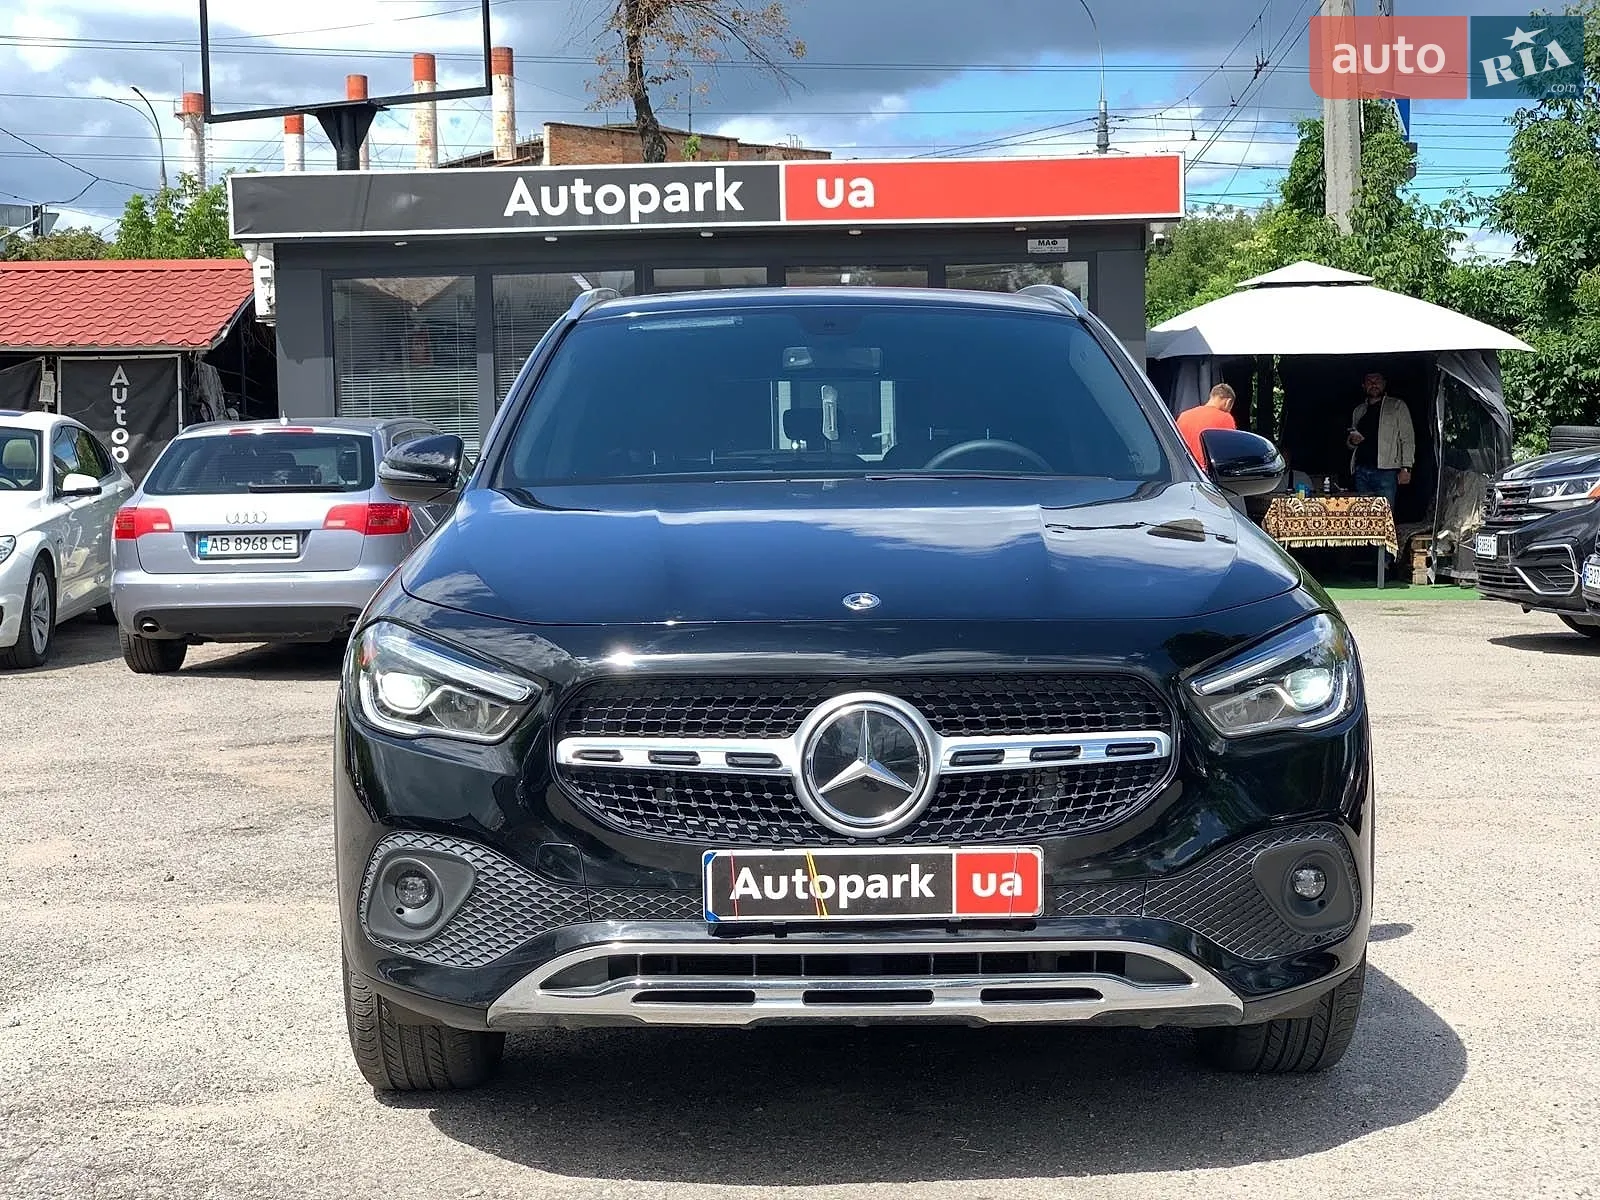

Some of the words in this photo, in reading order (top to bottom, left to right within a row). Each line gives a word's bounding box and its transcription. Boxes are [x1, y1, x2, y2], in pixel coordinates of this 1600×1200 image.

[503, 167, 745, 223] Autopark
[816, 175, 875, 209] ua
[210, 537, 230, 552] AB
[234, 536, 268, 551] 8968
[272, 536, 293, 551] CE
[729, 863, 936, 909] Autopark
[971, 871, 1023, 898] ua
